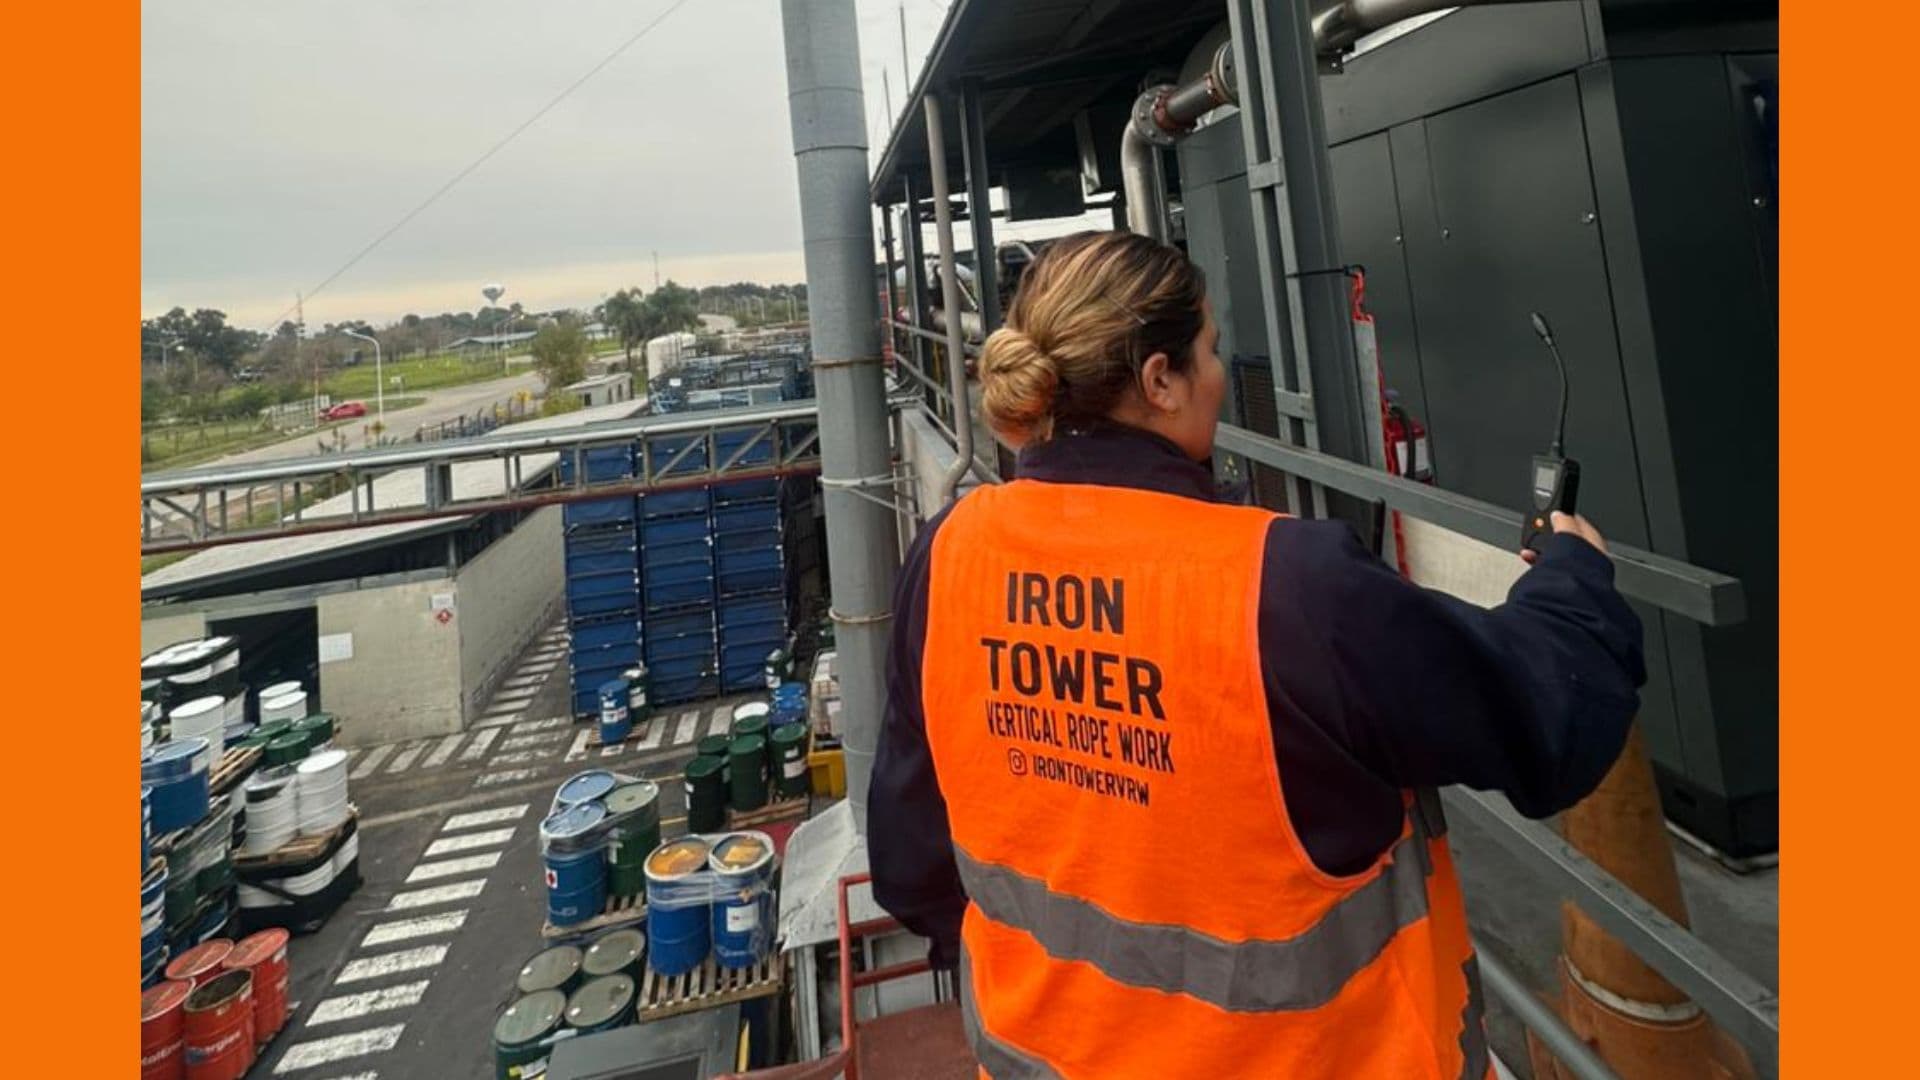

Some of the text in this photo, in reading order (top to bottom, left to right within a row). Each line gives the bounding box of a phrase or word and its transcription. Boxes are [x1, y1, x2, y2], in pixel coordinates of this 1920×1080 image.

[1007, 571, 1124, 635] IRON
[980, 637, 1166, 720] TOWER
[985, 700, 1175, 774] VERTICAL ROPE WORK
[1033, 755, 1149, 806] IRONTOWERVRW
